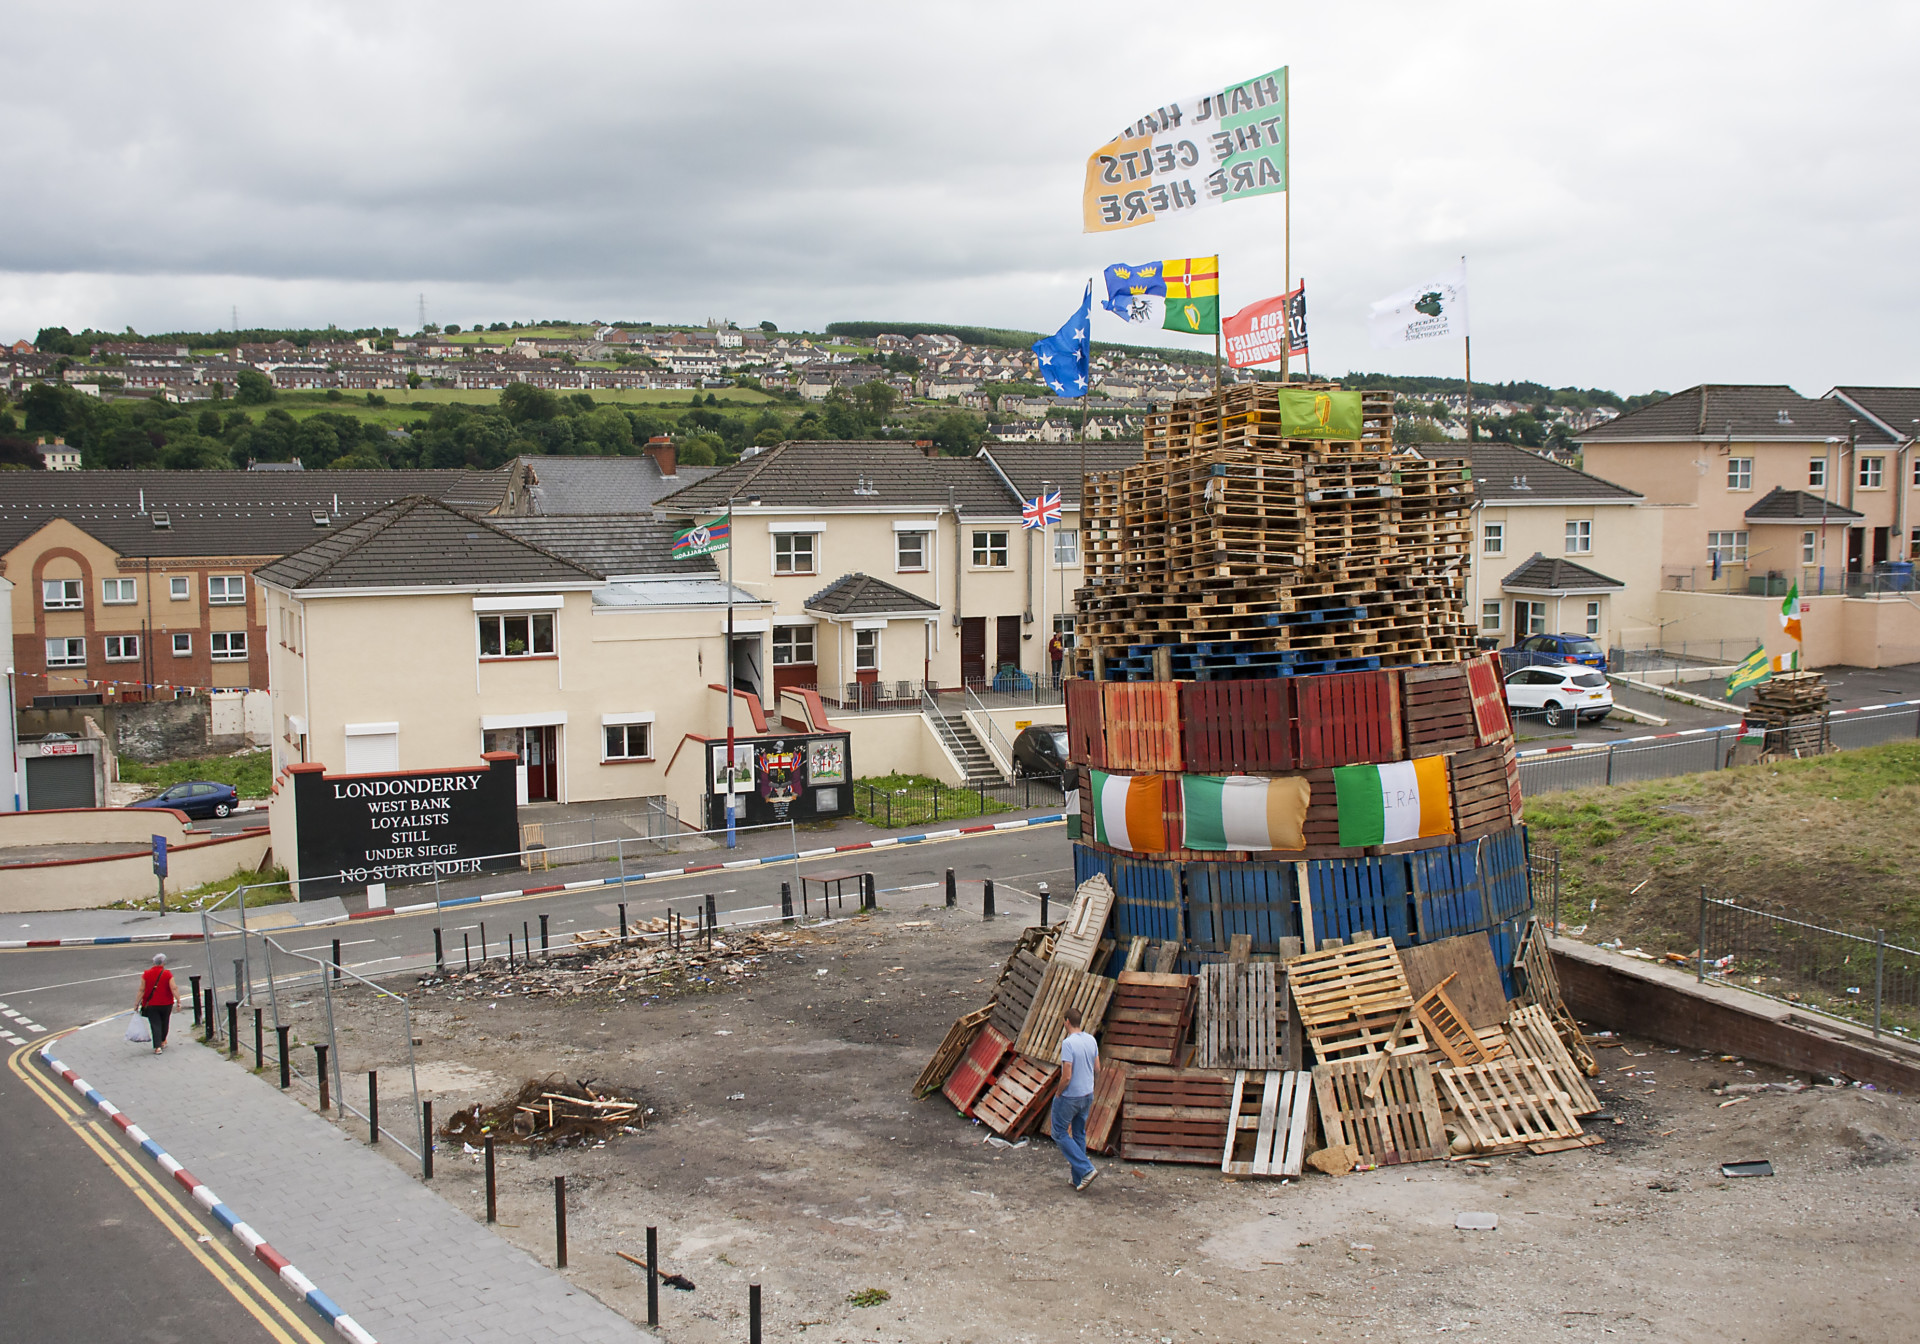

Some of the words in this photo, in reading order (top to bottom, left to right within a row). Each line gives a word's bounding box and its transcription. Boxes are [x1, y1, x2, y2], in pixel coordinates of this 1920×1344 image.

[333, 774, 482, 799] LONDONDERRY
[368, 800, 407, 814] WEST
[410, 797, 451, 811] BANK
[371, 813, 449, 830] LOYALISTS
[391, 830, 430, 844] STILL
[365, 847, 415, 861] UNDER
[417, 843, 458, 857] SIEGE
[340, 867, 368, 884] NO
[373, 859, 482, 880] SURRENDER
